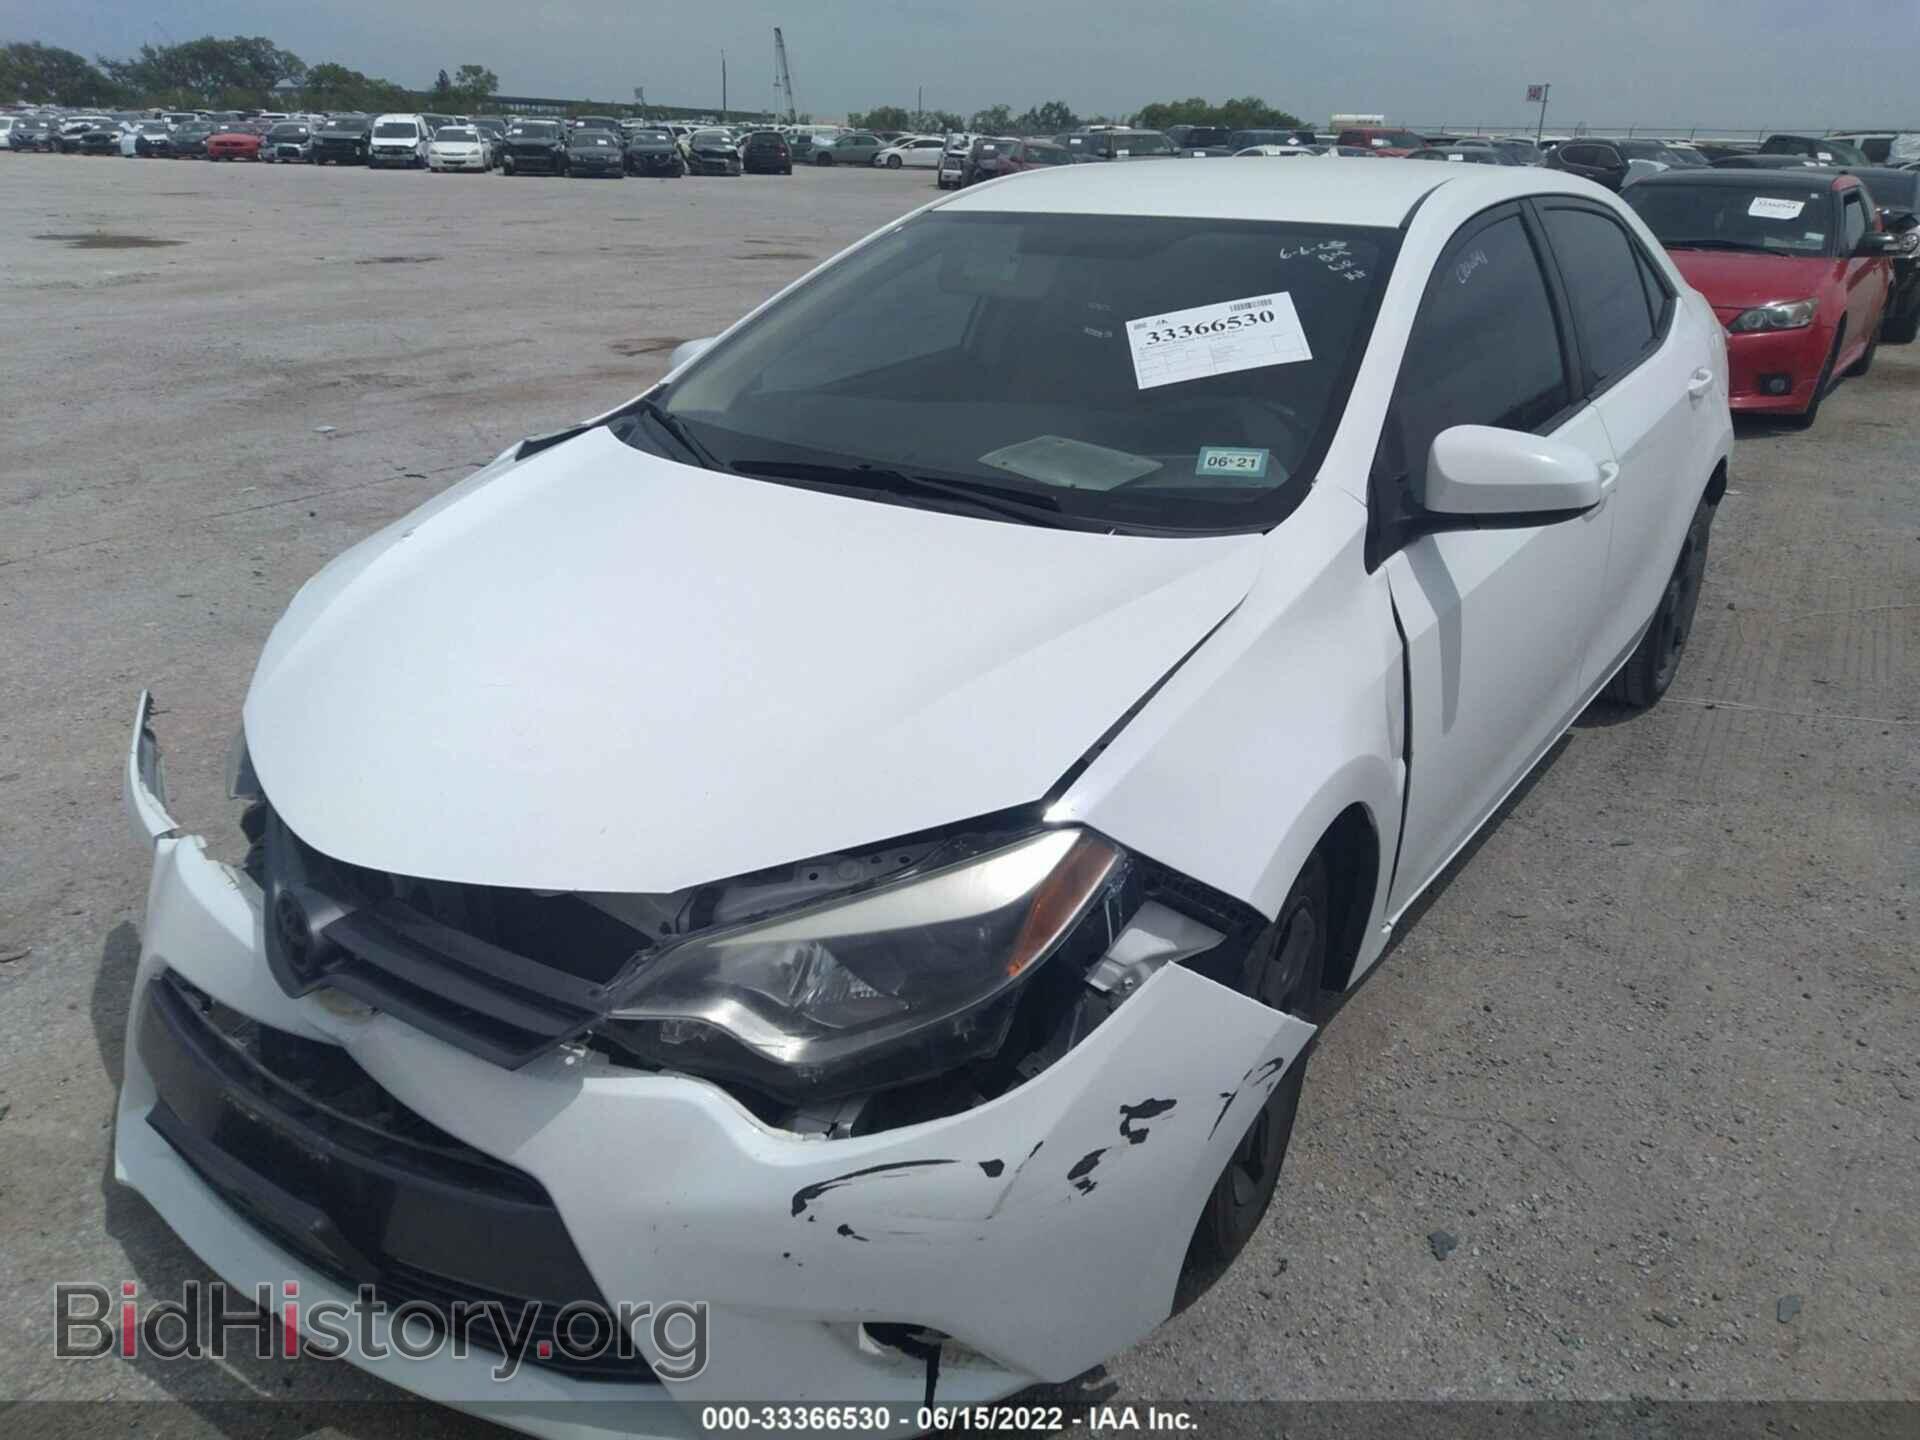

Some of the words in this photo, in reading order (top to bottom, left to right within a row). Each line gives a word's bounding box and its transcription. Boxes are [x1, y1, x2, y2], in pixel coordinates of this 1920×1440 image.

[1146, 310, 1275, 345] 33366530
[1207, 456, 1228, 467] 06
[1236, 457, 1256, 468] 21
